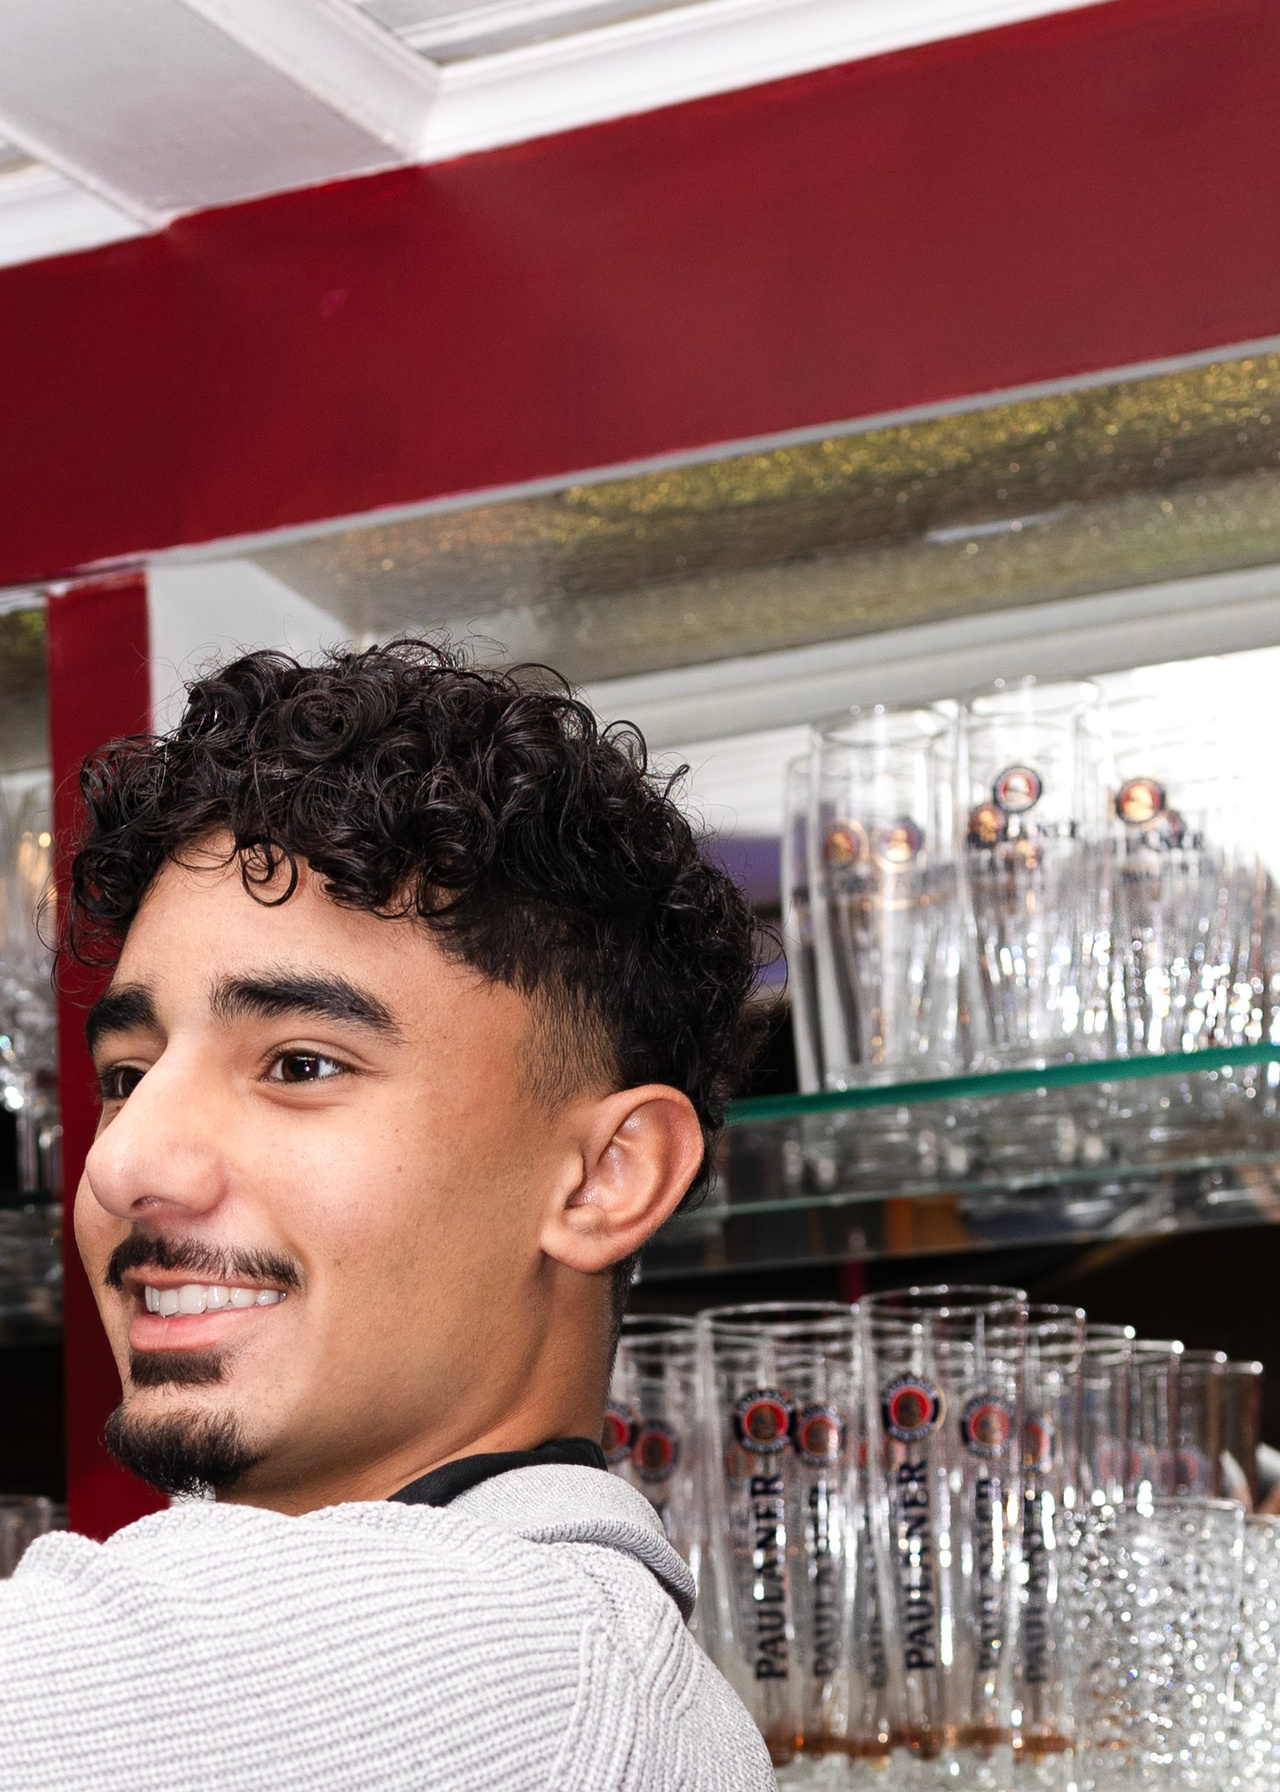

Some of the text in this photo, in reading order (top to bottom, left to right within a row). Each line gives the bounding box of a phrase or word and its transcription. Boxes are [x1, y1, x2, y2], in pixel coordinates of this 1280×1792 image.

[751, 1473, 788, 1681] PAULANER
[809, 1483, 835, 1678] PAULAR
[899, 1459, 936, 1671] PAULANER
